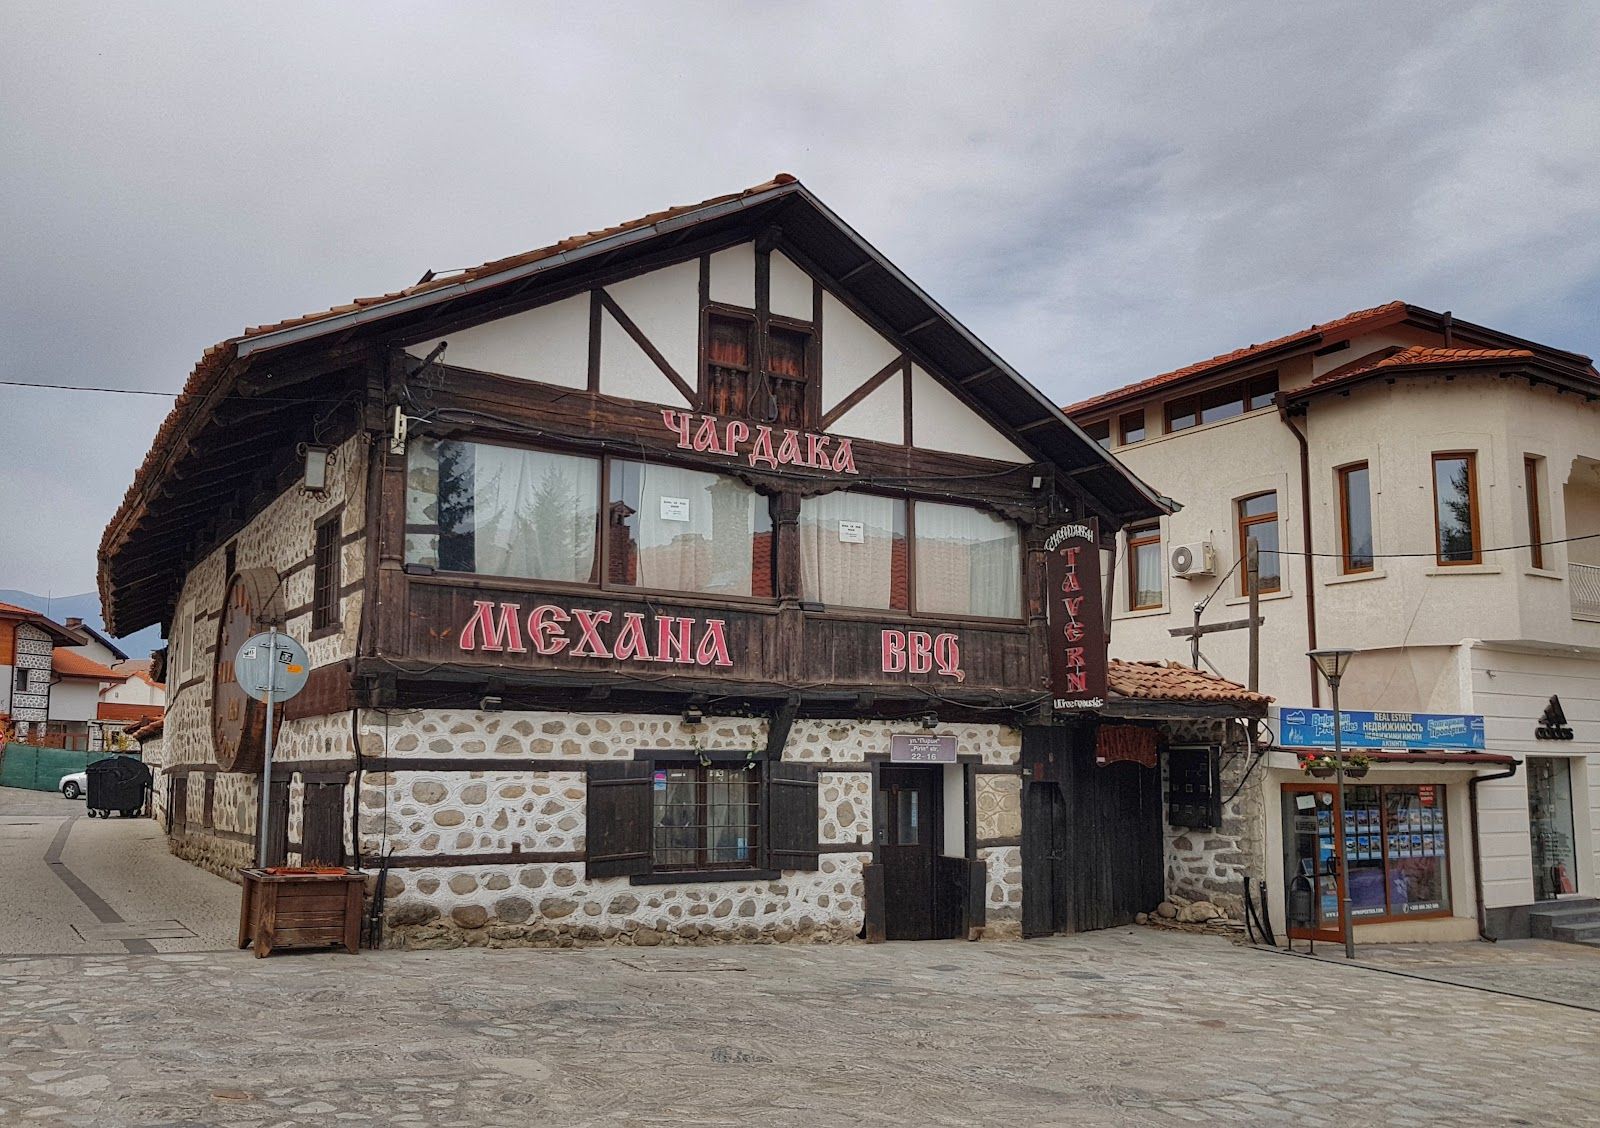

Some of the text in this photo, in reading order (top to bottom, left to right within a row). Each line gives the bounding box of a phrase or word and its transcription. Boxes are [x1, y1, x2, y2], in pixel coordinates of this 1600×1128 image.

[660, 409, 859, 475] ЧАРДАКА
[459, 600, 733, 666] МЕХАНА
[1060, 546, 1089, 693] TAVERN
[881, 629, 965, 683] BBQ
[1363, 722, 1424, 733] НЕДВИЖИМОСТЬ
[1374, 713, 1413, 722] REAL ESTATE
